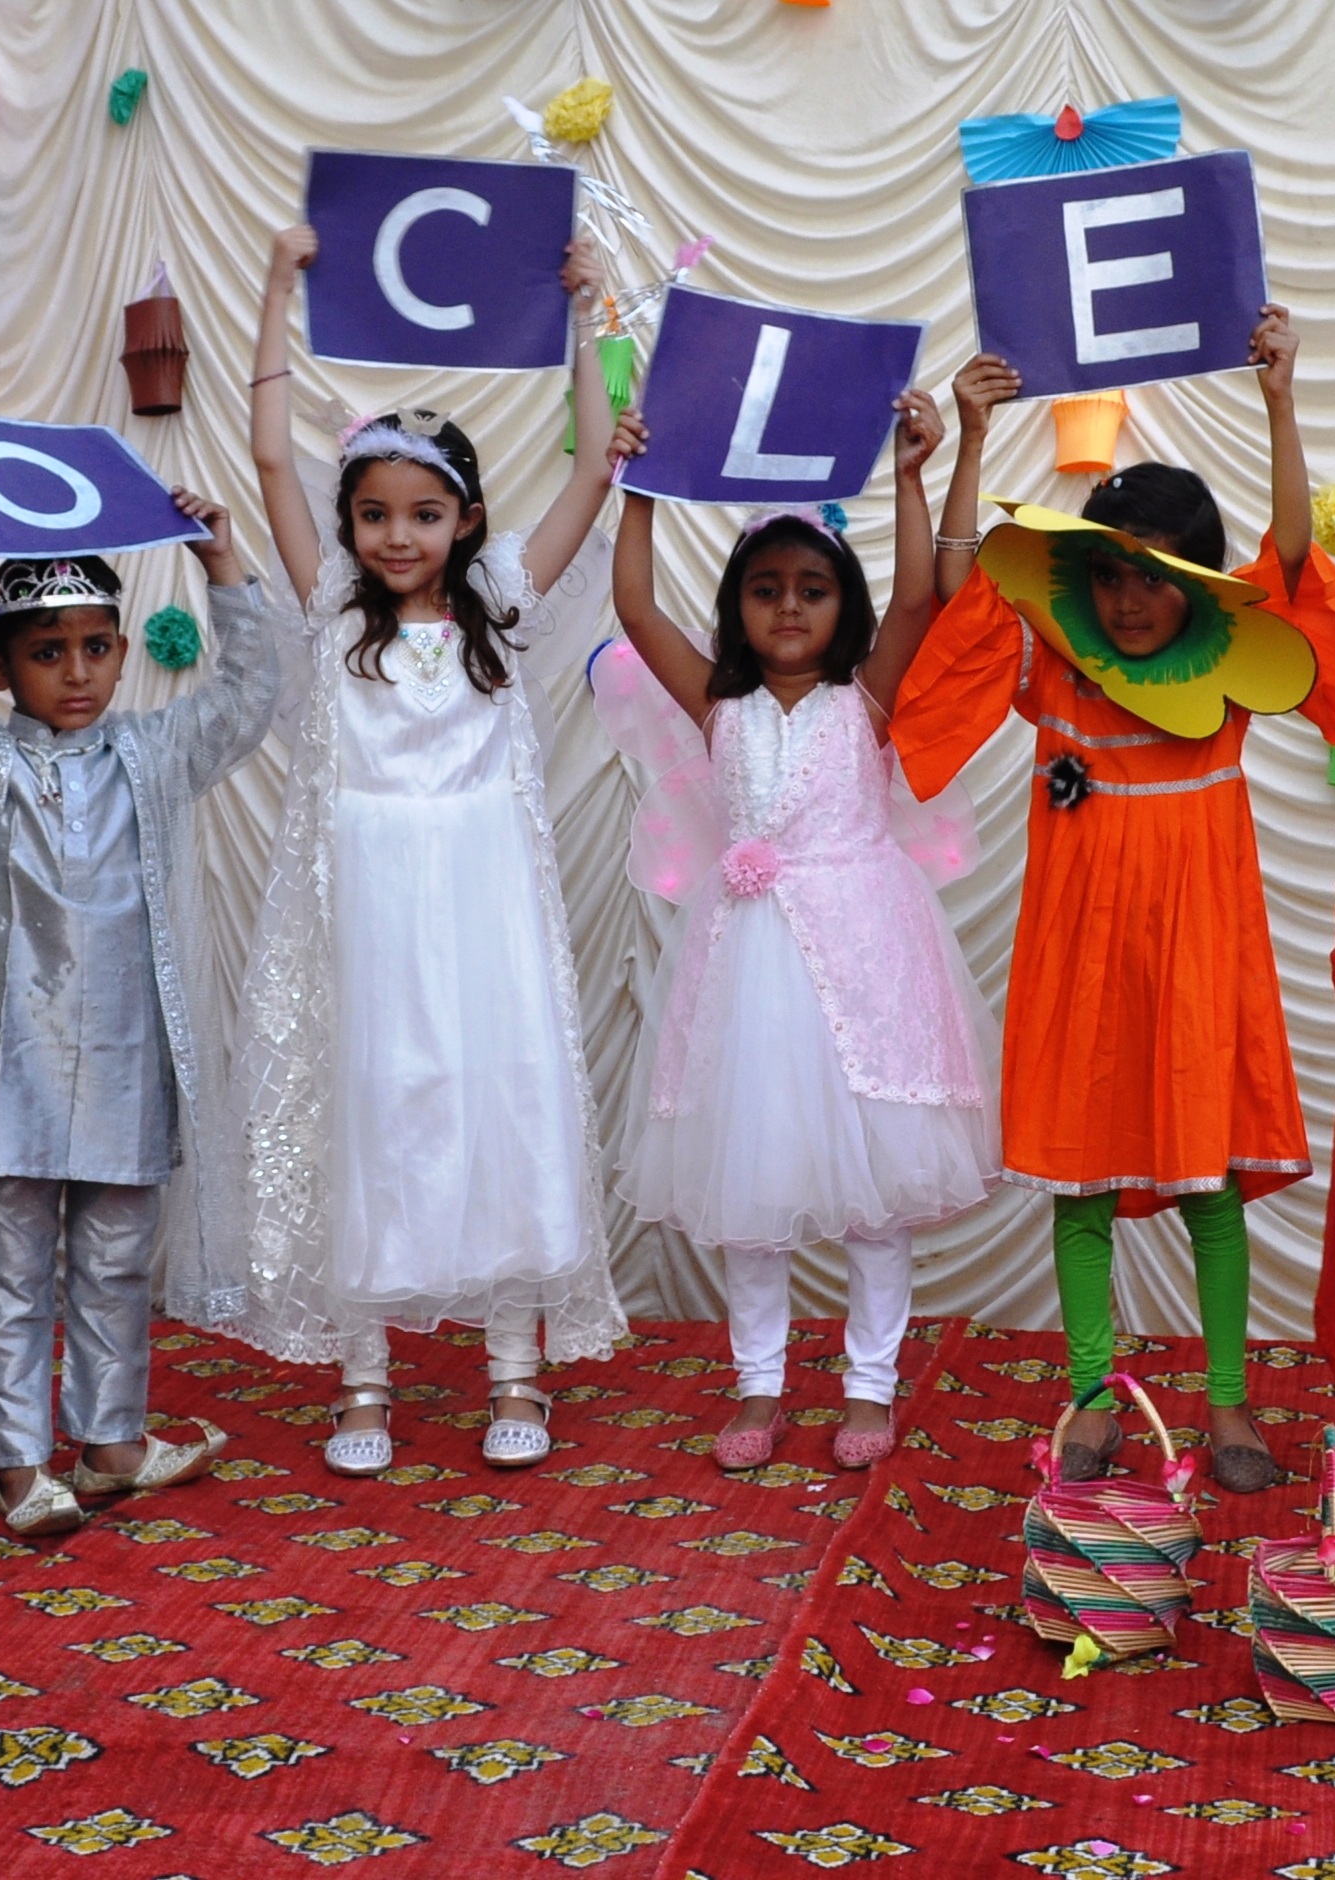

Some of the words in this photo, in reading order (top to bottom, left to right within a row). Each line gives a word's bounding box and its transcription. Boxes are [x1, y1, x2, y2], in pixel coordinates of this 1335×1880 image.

[373, 186, 492, 331] C
[1062, 187, 1201, 365] E
[720, 324, 836, 482] L
